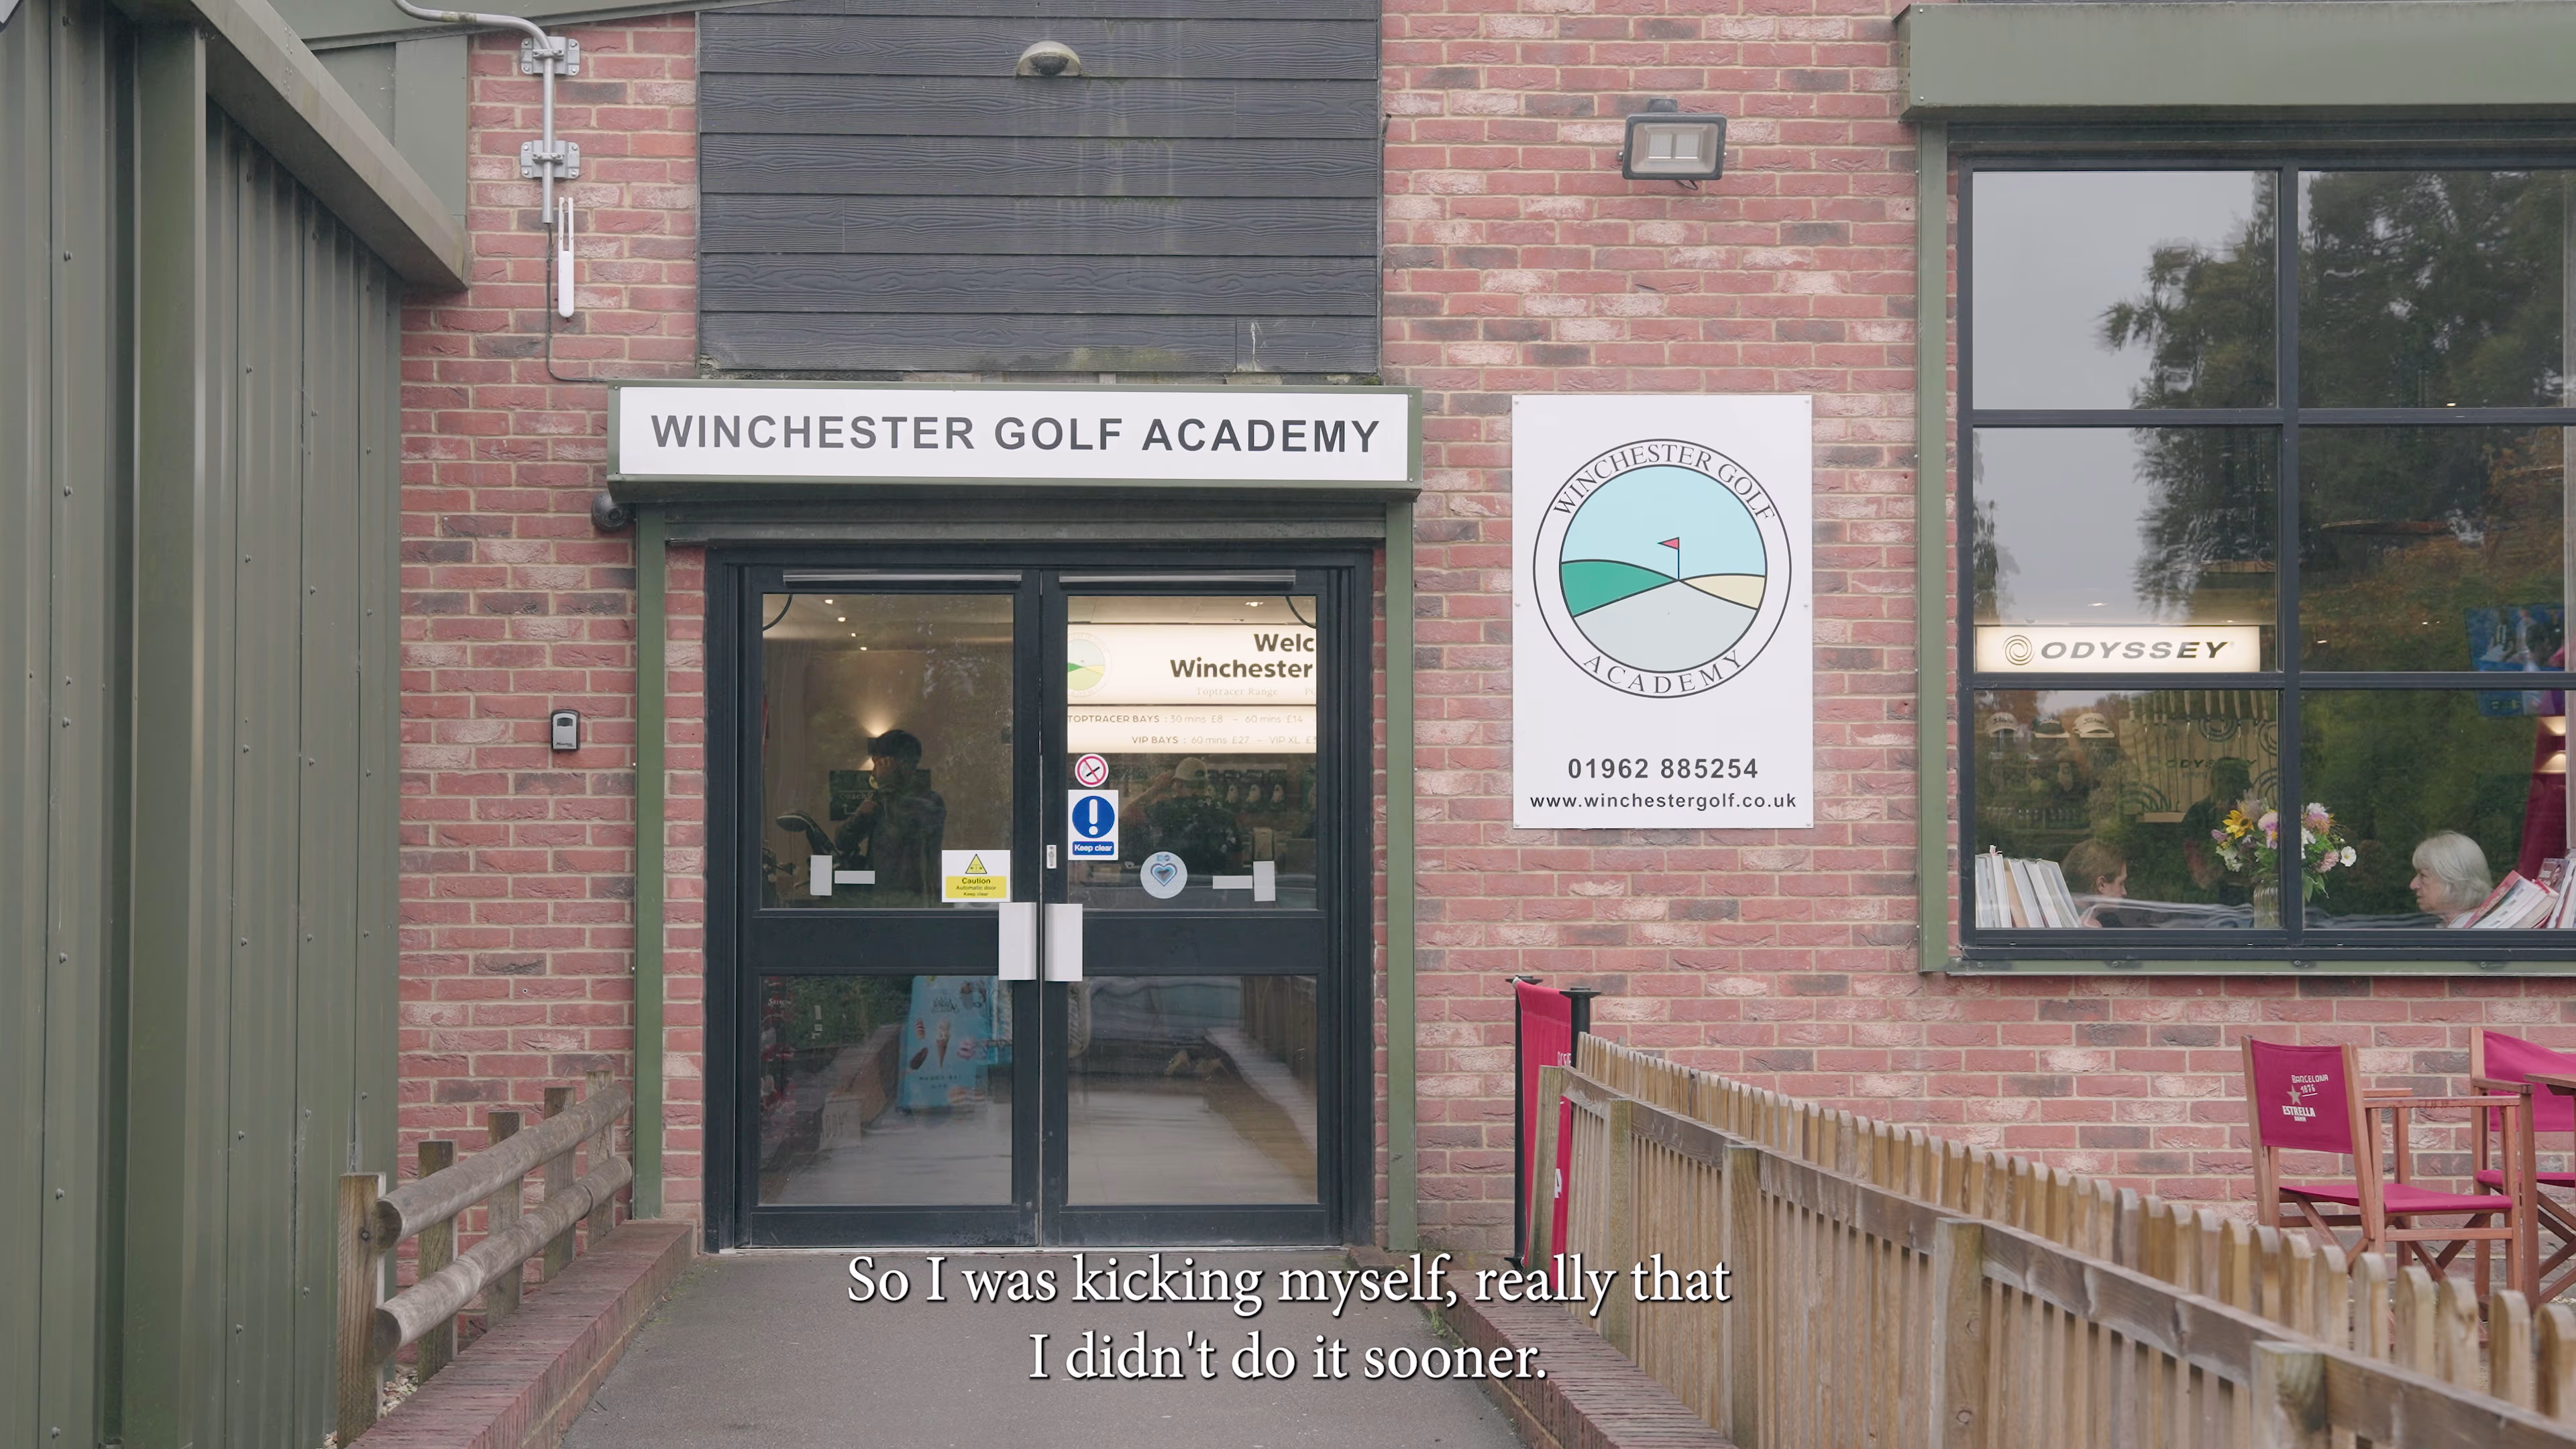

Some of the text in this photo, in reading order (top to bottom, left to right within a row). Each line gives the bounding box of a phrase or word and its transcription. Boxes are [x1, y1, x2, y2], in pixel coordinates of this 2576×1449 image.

[651, 415, 1379, 453] WINCHESTER GOLF ACADEMY
[1553, 443, 1776, 522] WINCHESTER GOLF
[2041, 641, 2228, 659] ODYSSEY
[1170, 657, 1313, 678] Winchester
[1583, 649, 1743, 694] ACADEMY
[1197, 688, 1278, 698] Toptracer Range
[1068, 715, 1130, 723] TOPTRACER
[1132, 715, 1160, 723] BAYS
[1171, 715, 1182, 723] 30
[1184, 715, 1207, 723] mins
[1212, 715, 1224, 723] £8
[1246, 715, 1257, 723] 60
[1260, 715, 1281, 723] mins
[1287, 715, 1303, 723] £14
[1132, 736, 1148, 744] VIP
[1151, 736, 1179, 744] BAYS
[1191, 736, 1203, 744] 60
[1205, 736, 1227, 744] mins
[1232, 736, 1250, 744] £27
[1269, 736, 1286, 744] VIP
[1568, 758, 1758, 779] 01962 885254
[1530, 793, 1796, 811] www.winchestergolf.co.uk
[1074, 844, 1112, 853] Keep clear
[2292, 1074, 2328, 1083] BARCELONA
[2300, 1084, 2316, 1093] 1876
[2282, 1105, 2316, 1117] ESTRELLA
